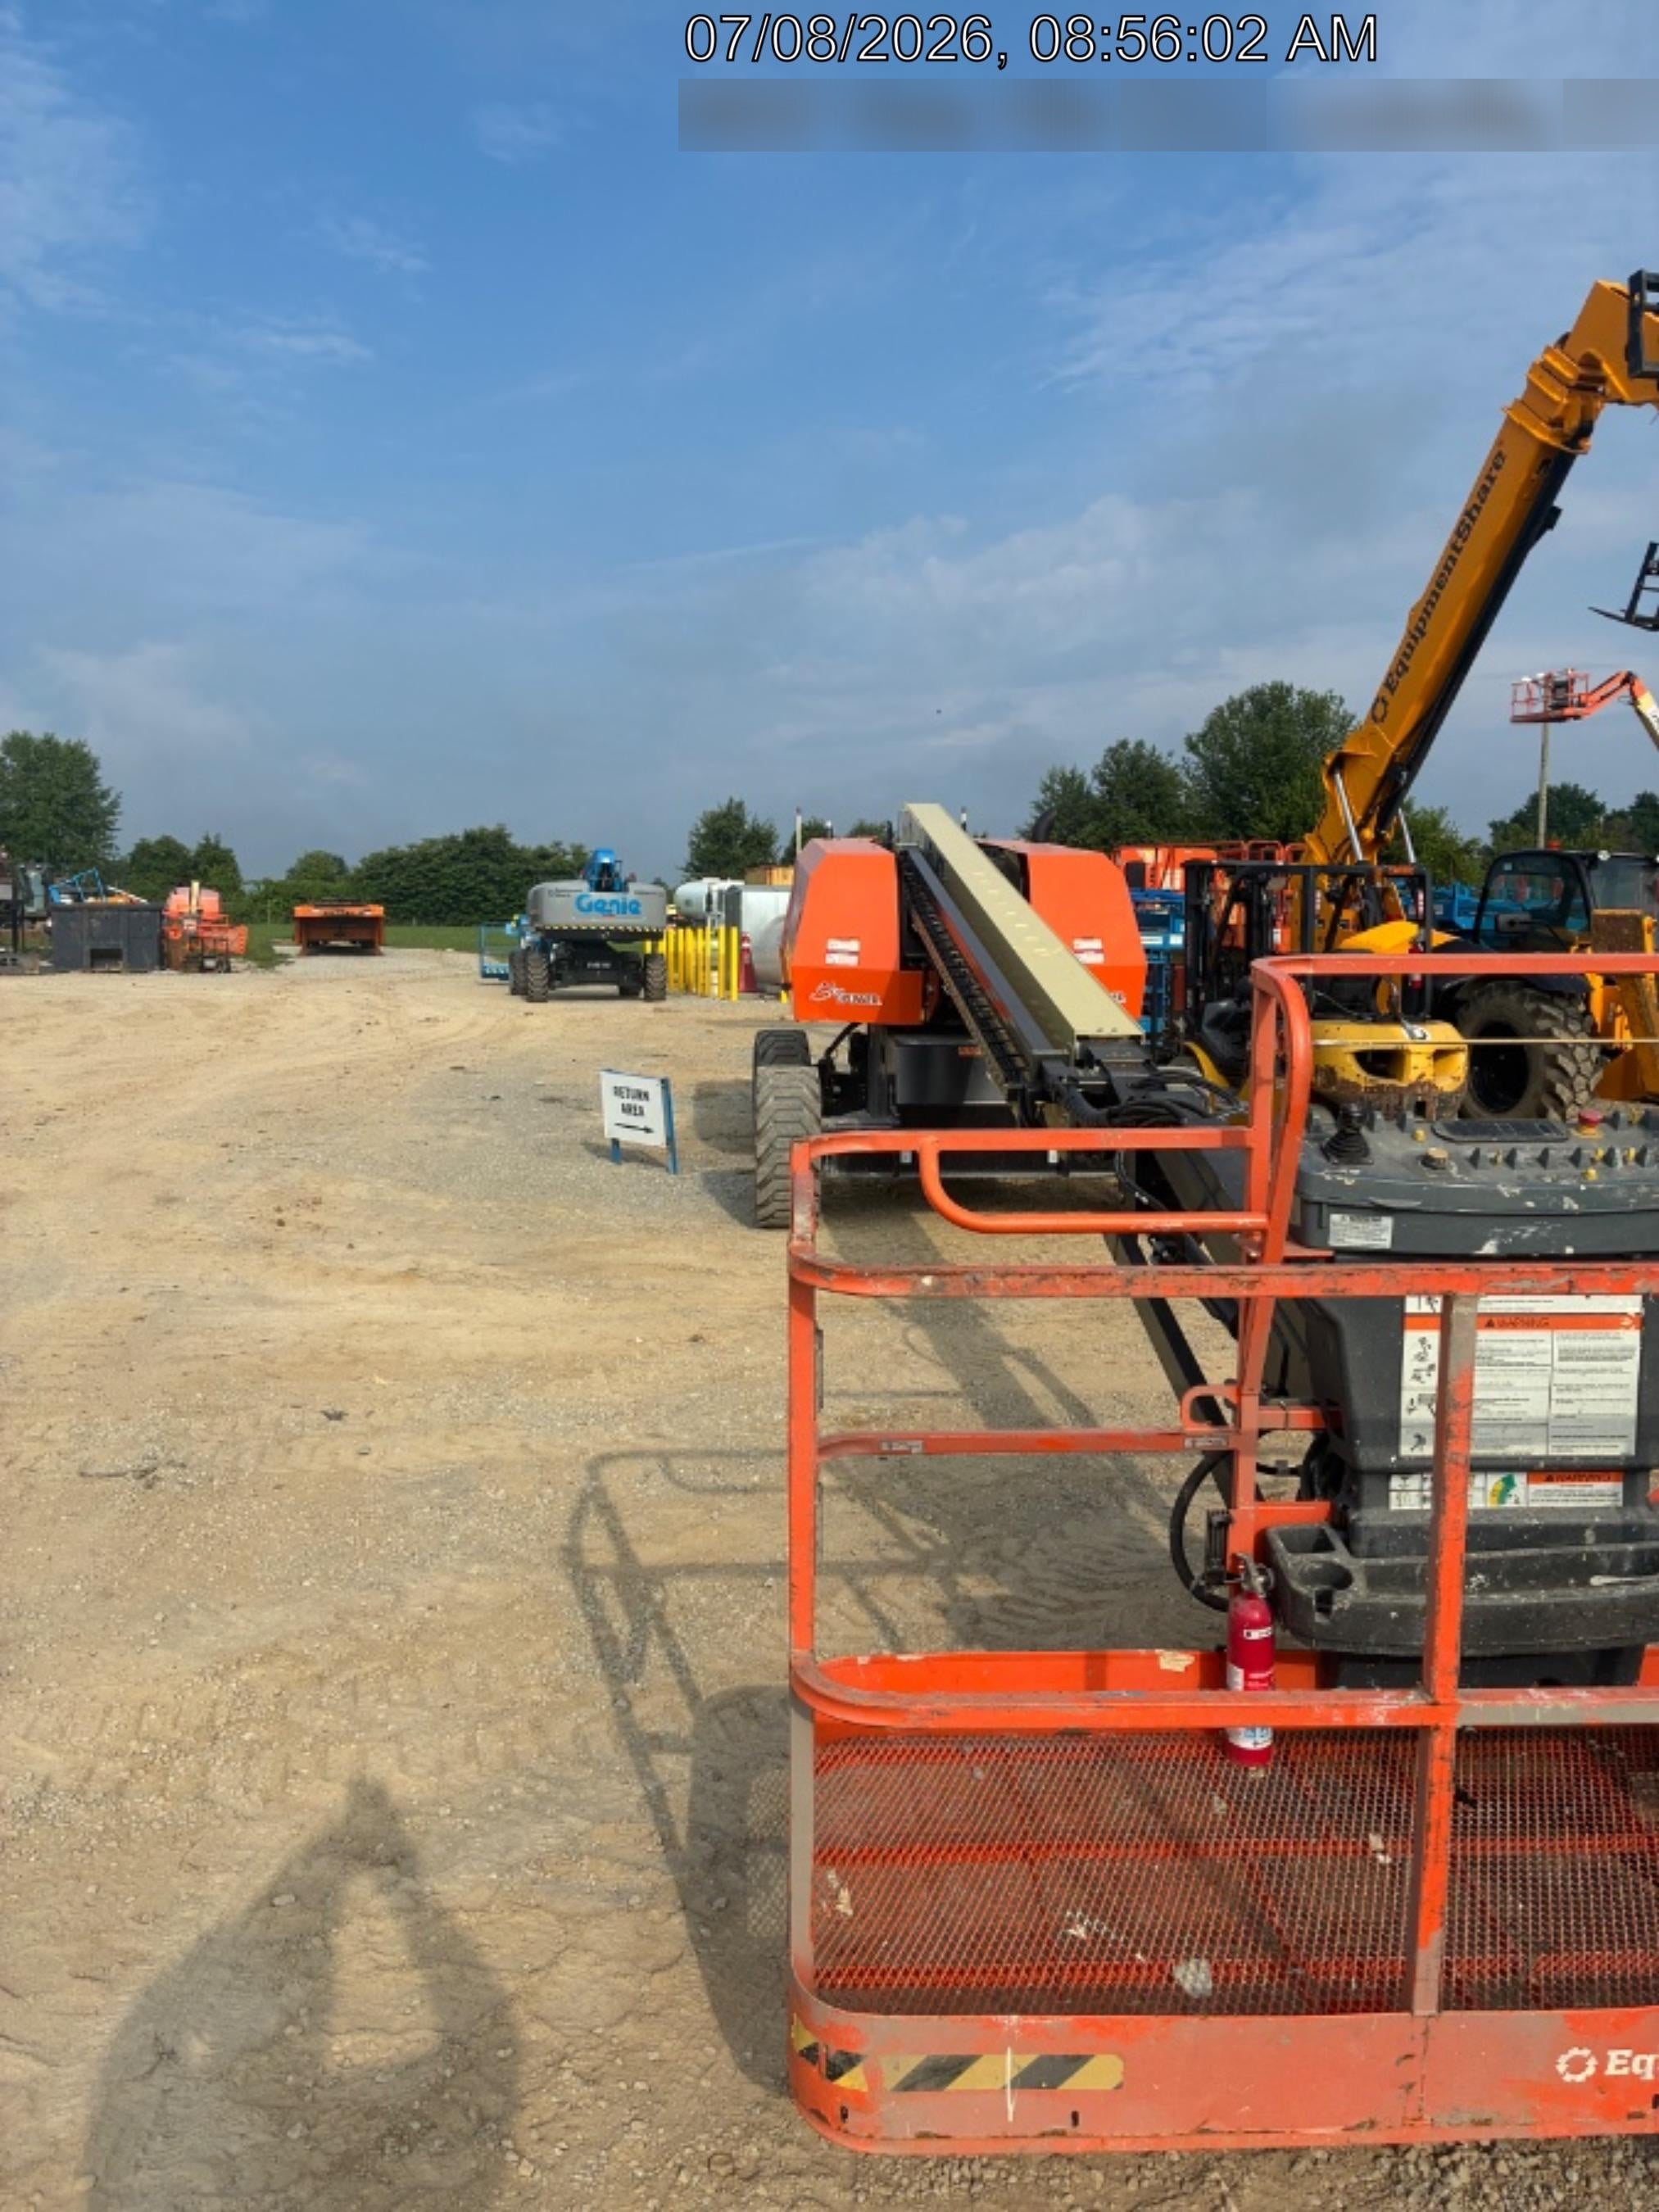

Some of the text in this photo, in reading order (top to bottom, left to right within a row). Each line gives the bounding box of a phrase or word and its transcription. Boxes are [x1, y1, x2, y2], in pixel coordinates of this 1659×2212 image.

[1384, 450, 1507, 696] EquipmentShare
[575, 893, 642, 915] Genie
[613, 1086, 650, 1102] RETURN
[620, 1103, 645, 1117] AREA
